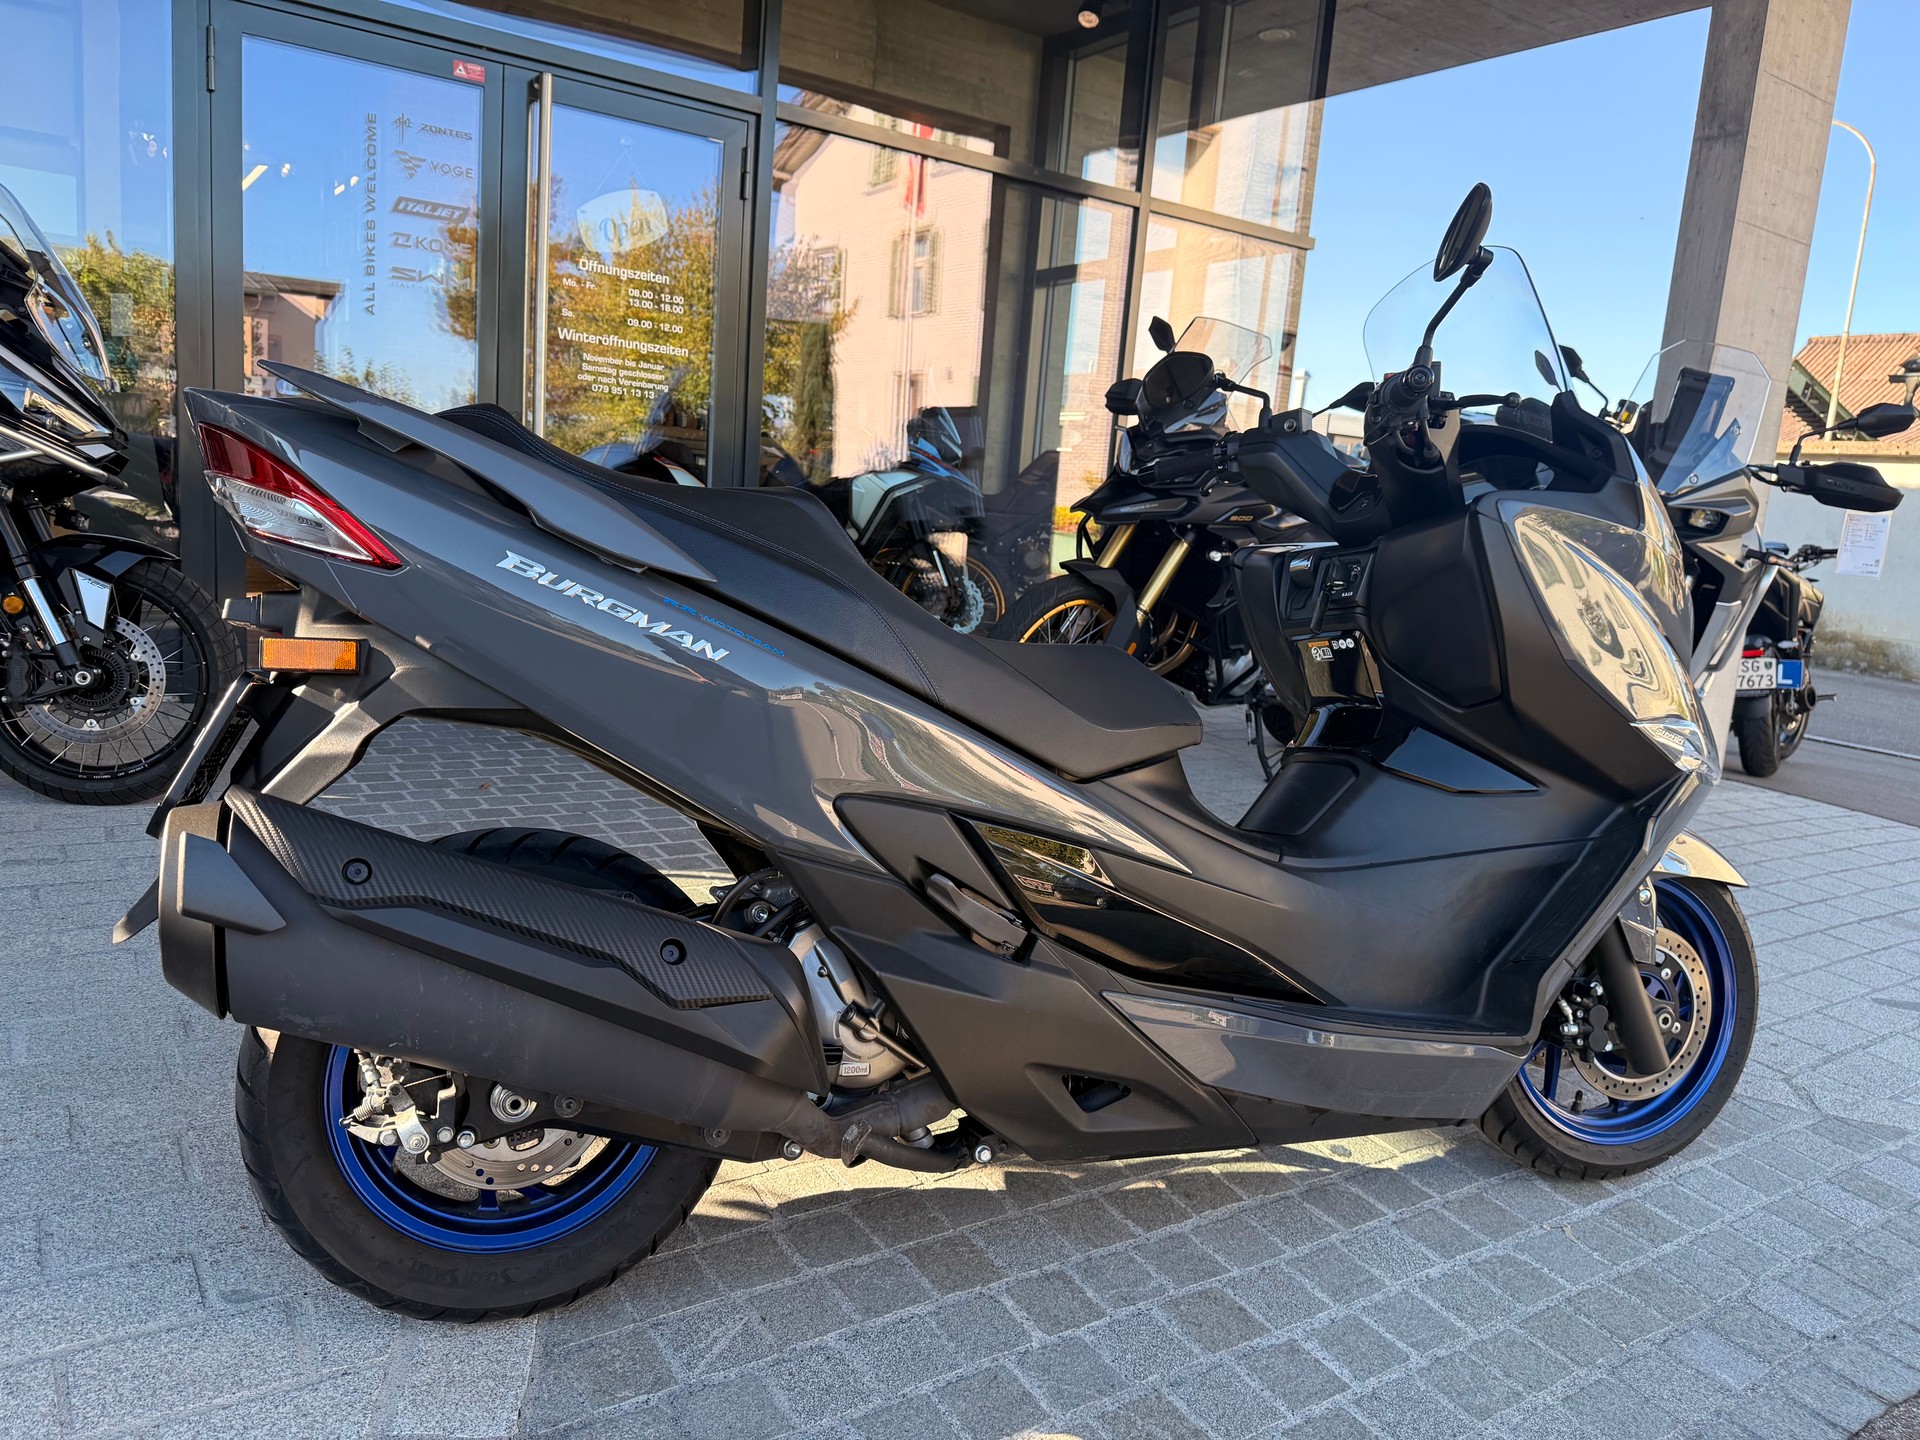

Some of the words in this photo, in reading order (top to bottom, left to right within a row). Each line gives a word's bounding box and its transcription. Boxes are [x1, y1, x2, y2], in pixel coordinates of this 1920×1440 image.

[419, 123, 473, 140] ZONTES
[367, 112, 377, 214] WELCOME
[430, 161, 474, 179] VOGE
[398, 201, 464, 219] ITALJET
[599, 217, 654, 247] Open
[366, 219, 376, 276] BIKES
[579, 256, 670, 284] Öffnungszeiten
[562, 278, 579, 288] Mo.
[586, 282, 598, 290] Fr.
[365, 282, 376, 316] ALL
[628, 288, 653, 299] 08.00
[660, 294, 684, 304] 12.00
[562, 309, 575, 318] Sa.
[629, 299, 653, 309] 13.00
[660, 304, 684, 314] 18.00
[627, 318, 652, 329] 09.00
[660, 323, 683, 333] 12.00
[557, 327, 689, 357] Winteröffnungszeiten
[583, 353, 624, 366] November
[625, 358, 637, 367] bis
[638, 360, 665, 371] Januar
[582, 363, 617, 376] Samstag
[619, 369, 665, 380] geschlossen
[577, 373, 596, 381] oder
[597, 376, 617, 385] nach
[618, 378, 669, 392] Vereinbarung
[592, 384, 609, 393] 079
[611, 387, 628, 396] 951
[630, 389, 641, 397] 13
[644, 391, 655, 399] 13
[496, 550, 730, 661] BURGMAN
[1741, 660, 1760, 673] SG
[1777, 663, 1793, 685] L
[1737, 674, 1774, 688] 7673
